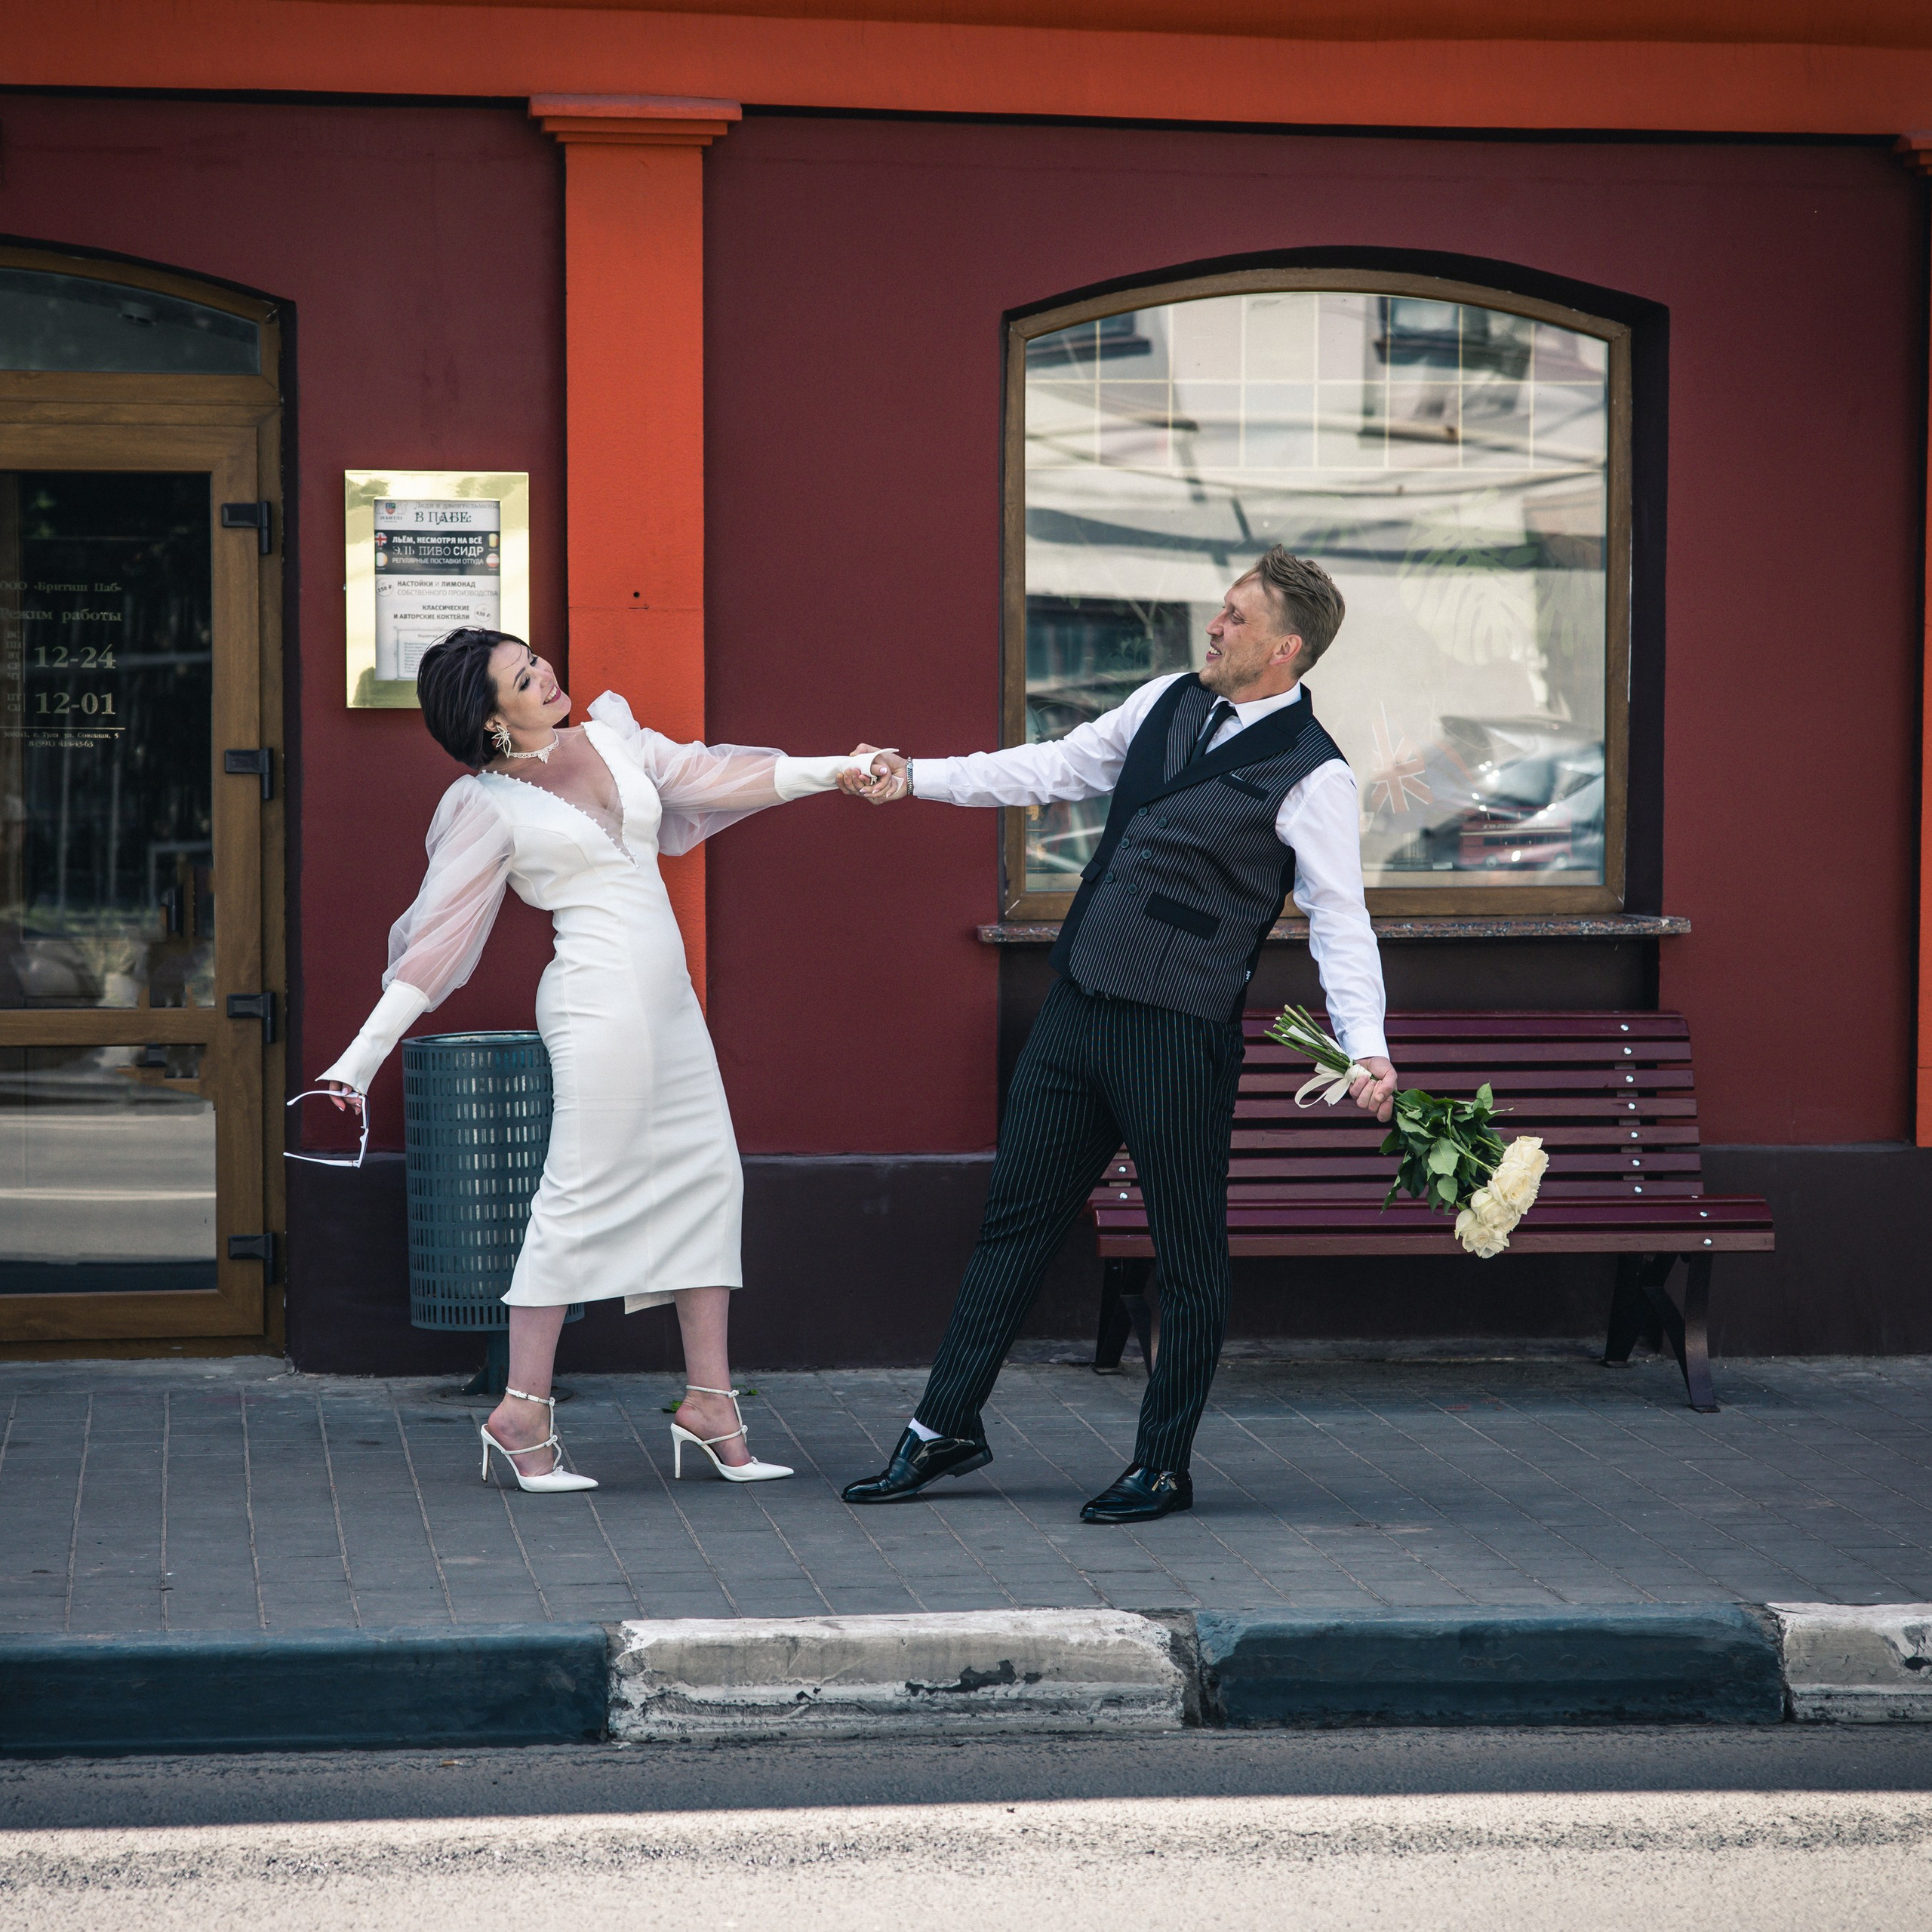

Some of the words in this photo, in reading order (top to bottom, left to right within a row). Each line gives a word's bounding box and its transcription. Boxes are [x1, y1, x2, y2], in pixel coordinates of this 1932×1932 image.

[415, 512, 424, 523] В
[428, 512, 472, 525] ПАБЕ:
[392, 535, 415, 545] ЛЬЁМ,
[469, 536, 483, 544] ВСЁ
[392, 546, 414, 555] ЭЛЬ
[419, 546, 451, 556] ПИВО
[453, 546, 484, 557] СИДР
[62, 608, 122, 623] работы
[35, 644, 115, 669] 12-24
[35, 692, 115, 715] 12-01
